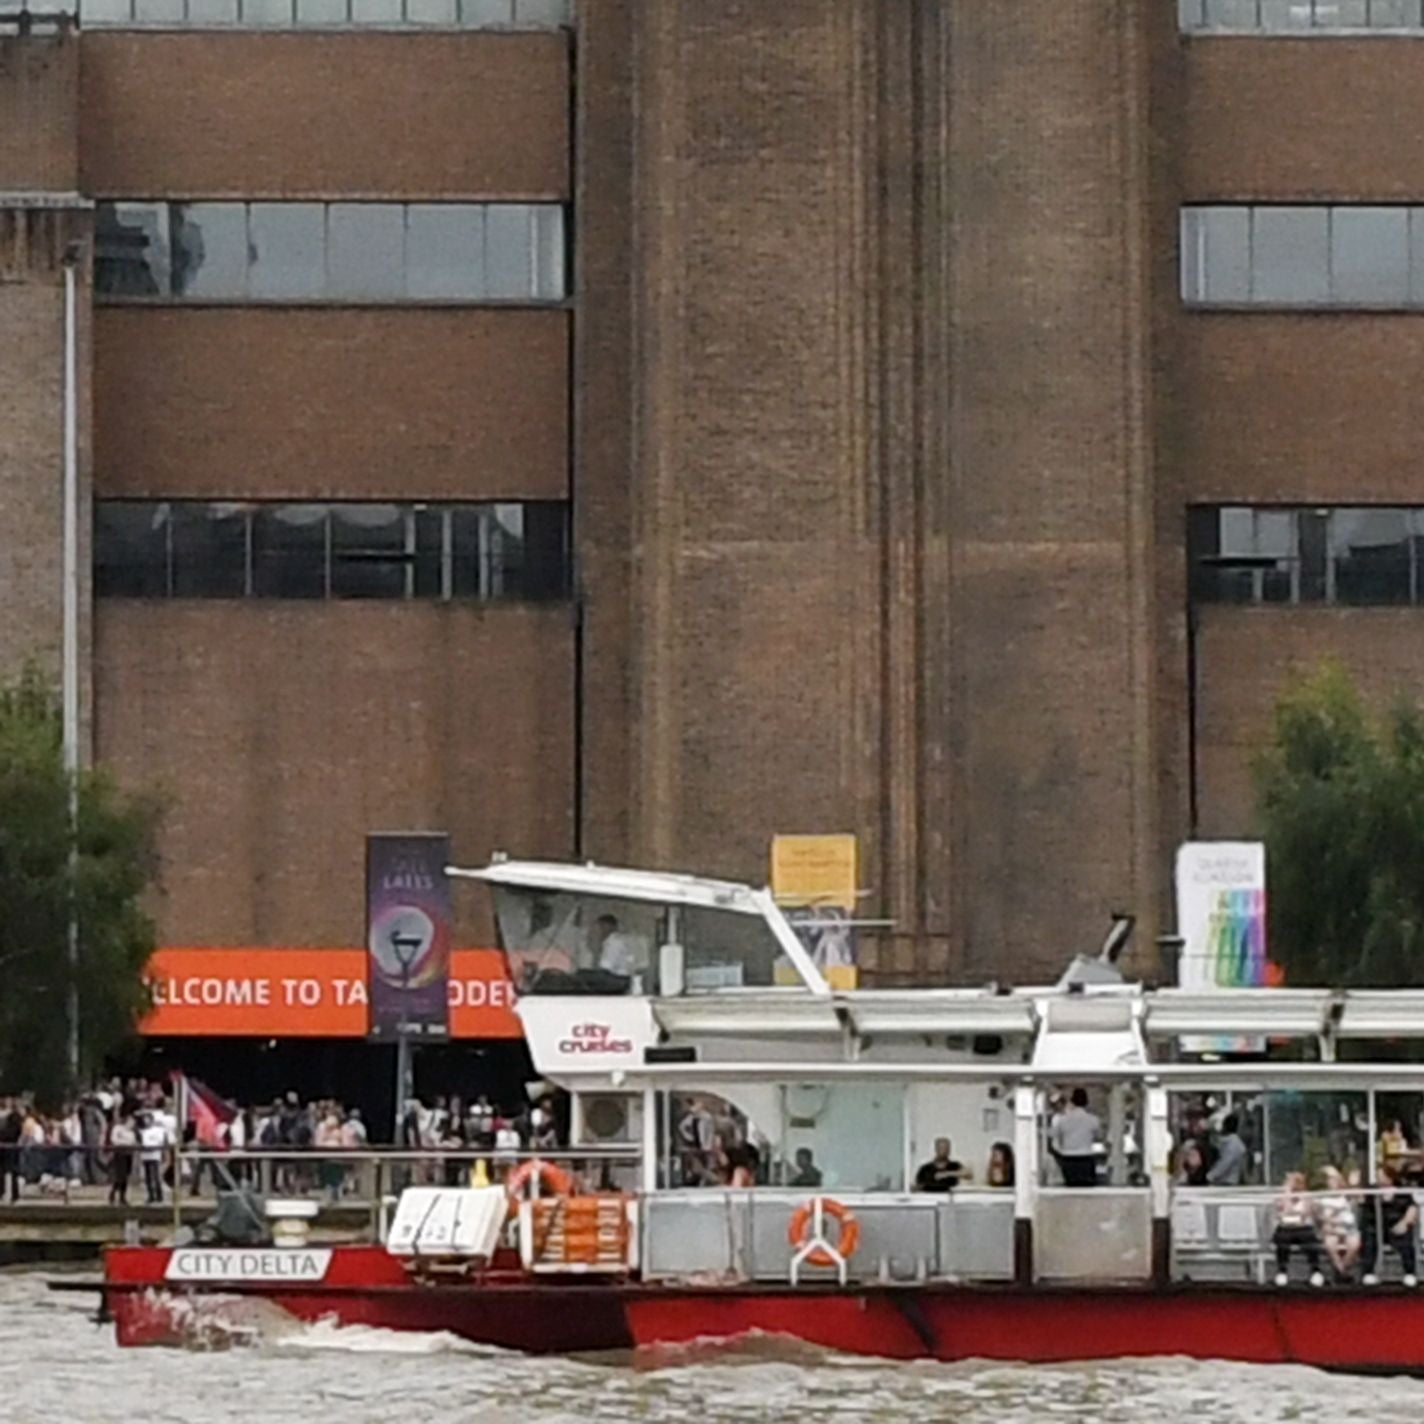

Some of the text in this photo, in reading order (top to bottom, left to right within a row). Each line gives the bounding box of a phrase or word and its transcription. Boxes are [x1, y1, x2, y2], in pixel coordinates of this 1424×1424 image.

[281, 979, 321, 1005] TO
[572, 1022, 611, 1041] city
[559, 1039, 632, 1053] cruises
[177, 1253, 318, 1275] CITY DELTA
